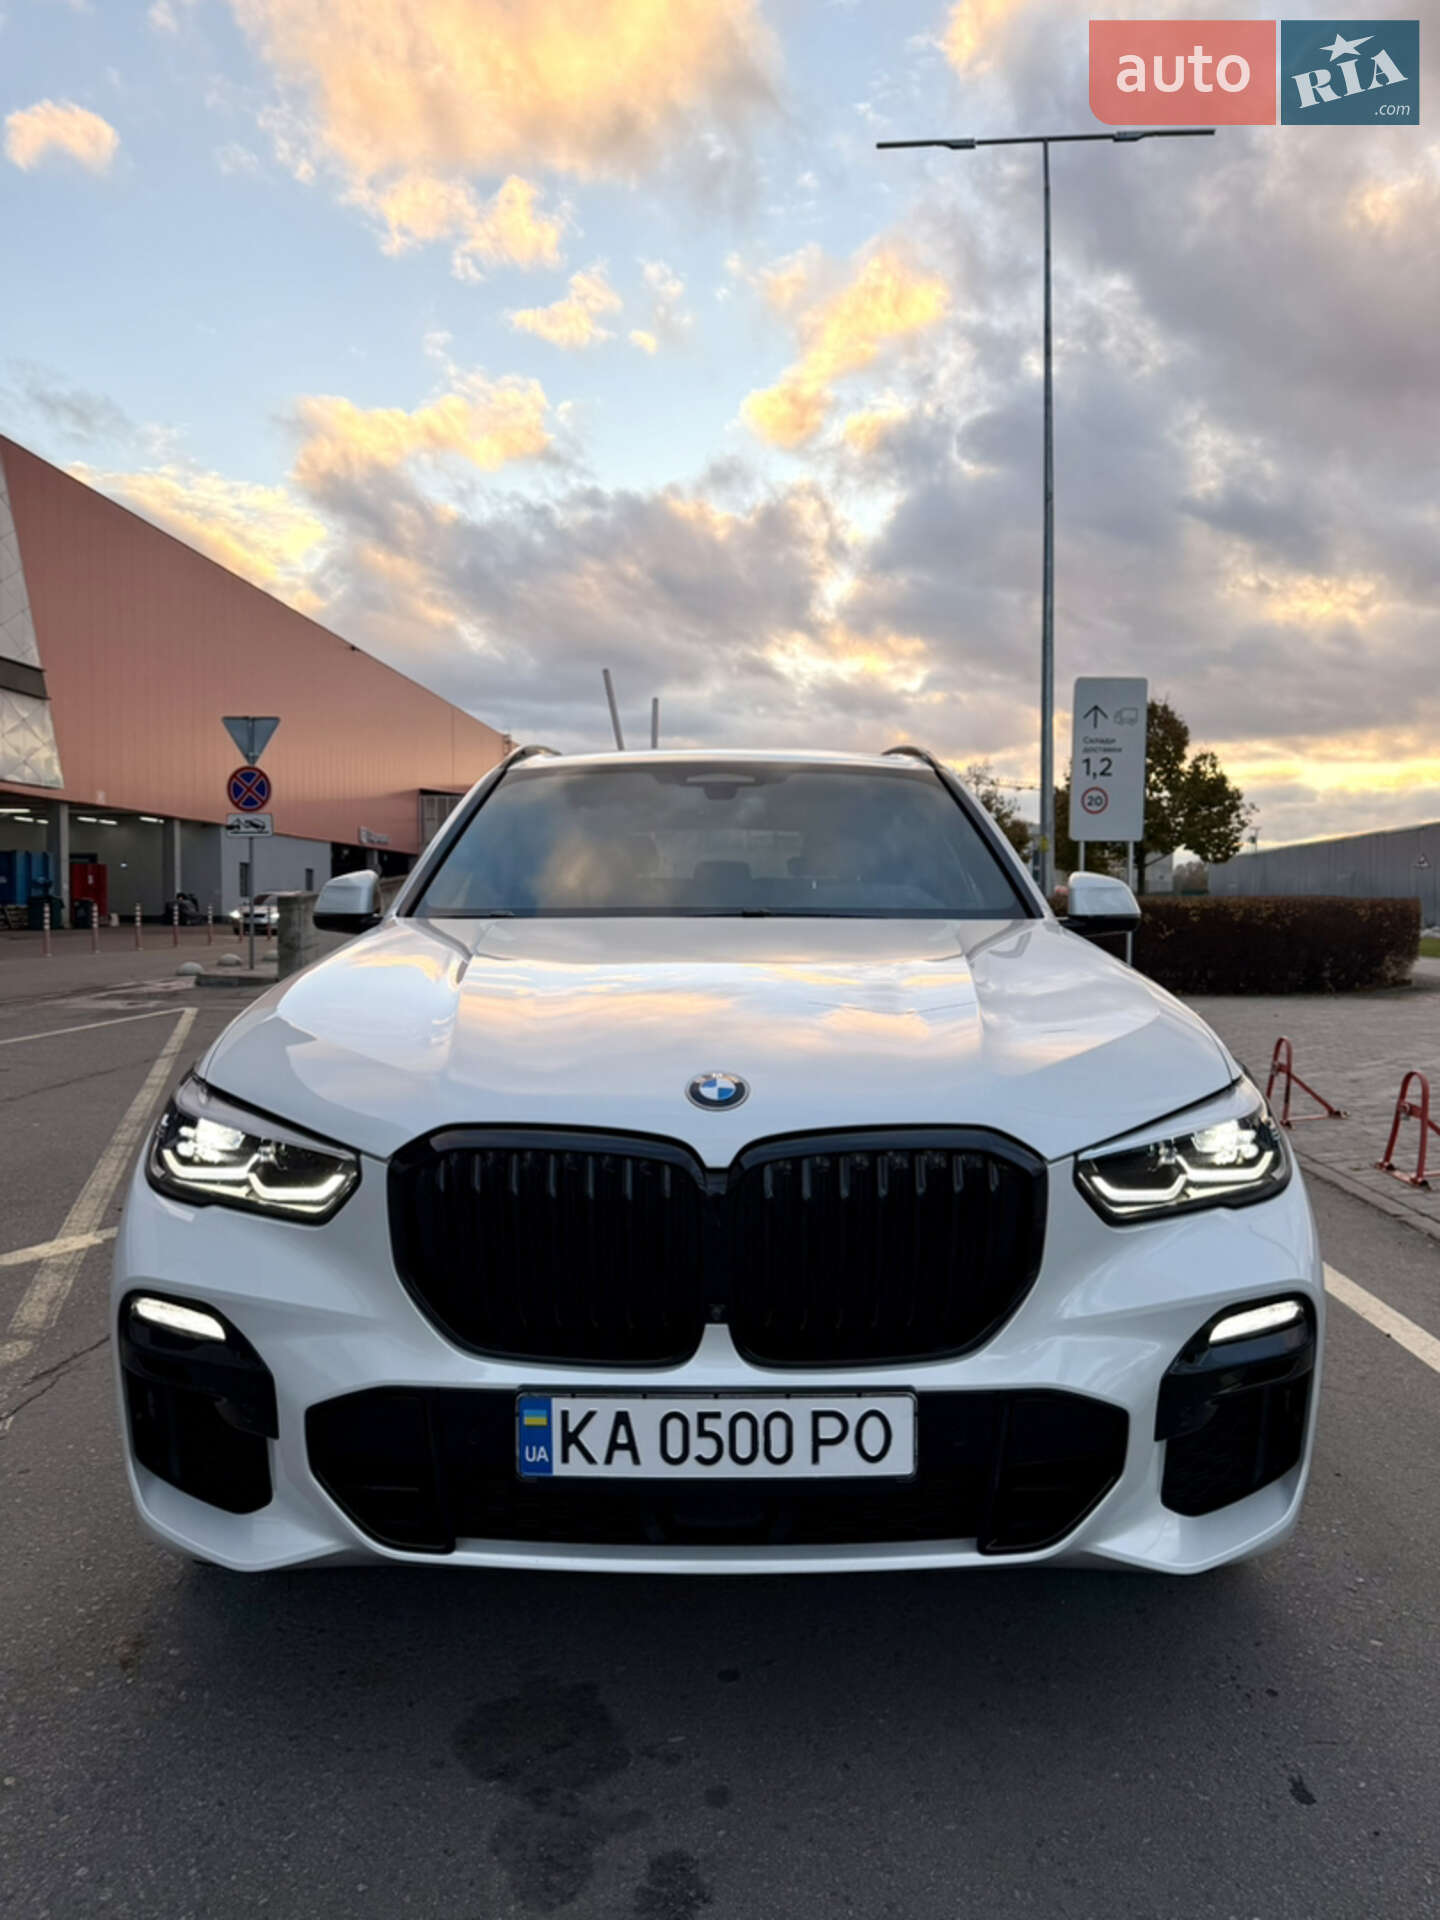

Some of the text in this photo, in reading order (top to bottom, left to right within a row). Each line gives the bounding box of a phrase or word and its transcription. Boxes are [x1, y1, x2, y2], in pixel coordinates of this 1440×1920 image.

[1082, 757, 1113, 780] 1,2
[1087, 795, 1103, 807] 20
[560, 1408, 893, 1466] KA 0500 PO
[524, 1446, 549, 1463] UA
